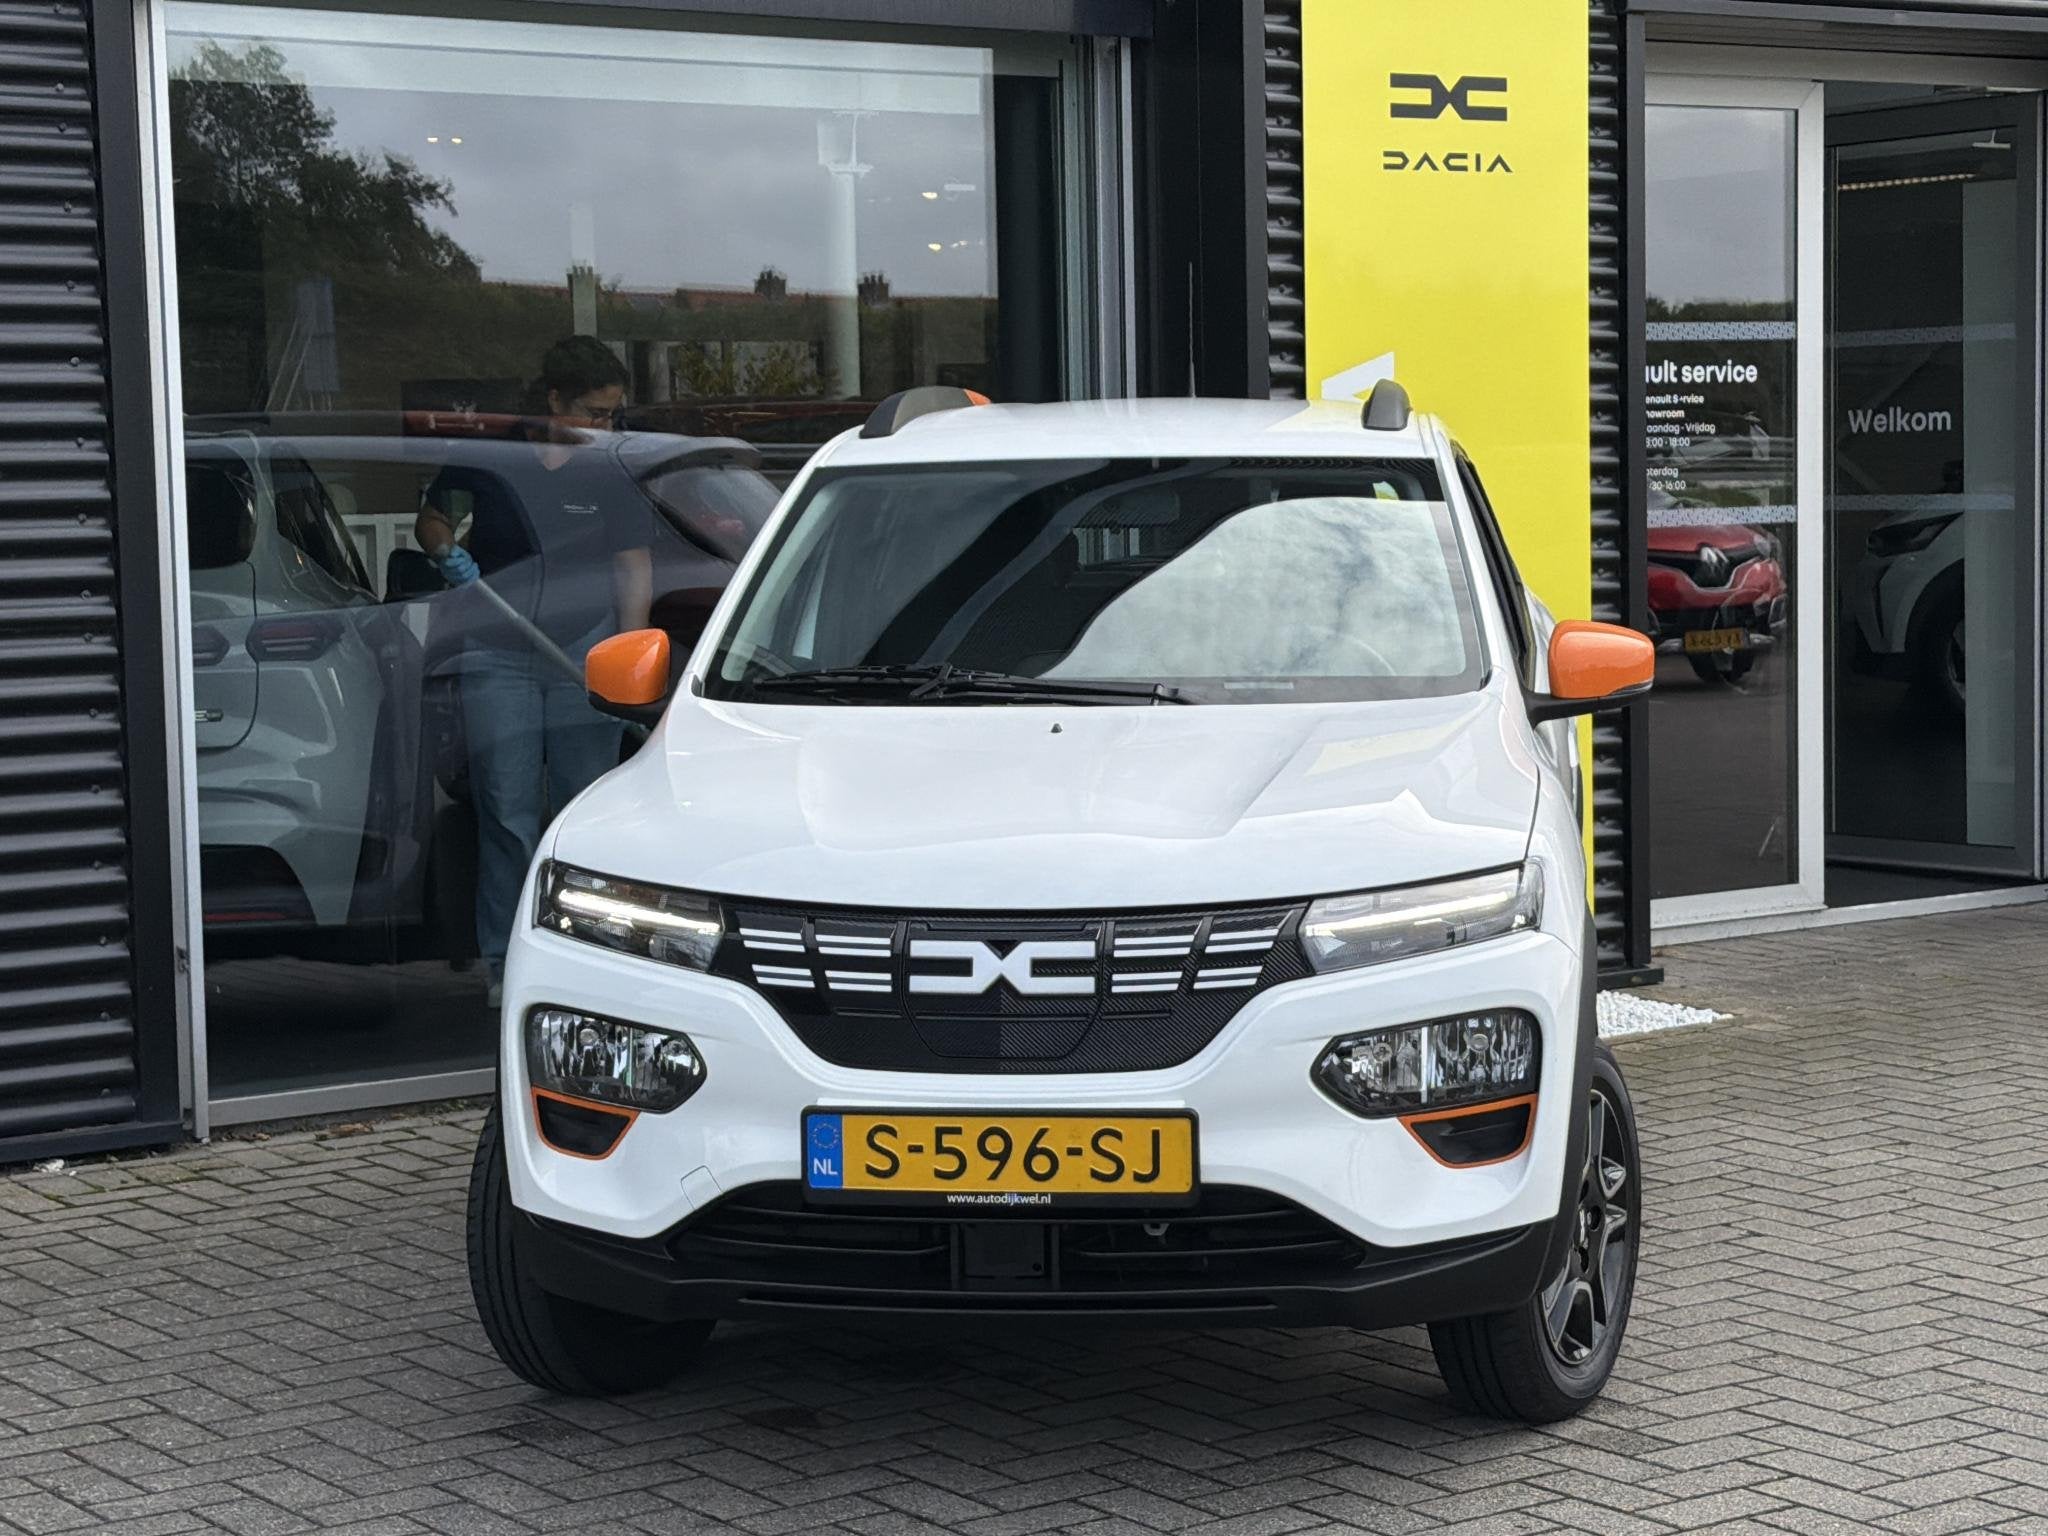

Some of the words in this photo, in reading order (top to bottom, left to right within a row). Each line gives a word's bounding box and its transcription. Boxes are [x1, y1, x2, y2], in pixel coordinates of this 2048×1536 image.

[1383, 150, 1513, 173] DACIA
[1681, 359, 1758, 384] service
[1685, 422, 1716, 435] Vrijdag
[1847, 406, 1952, 434] Welkom
[813, 1158, 838, 1176] NL
[865, 1124, 1161, 1183] S-596-SJ
[947, 1193, 1052, 1207] www.autodijkwel.nl
